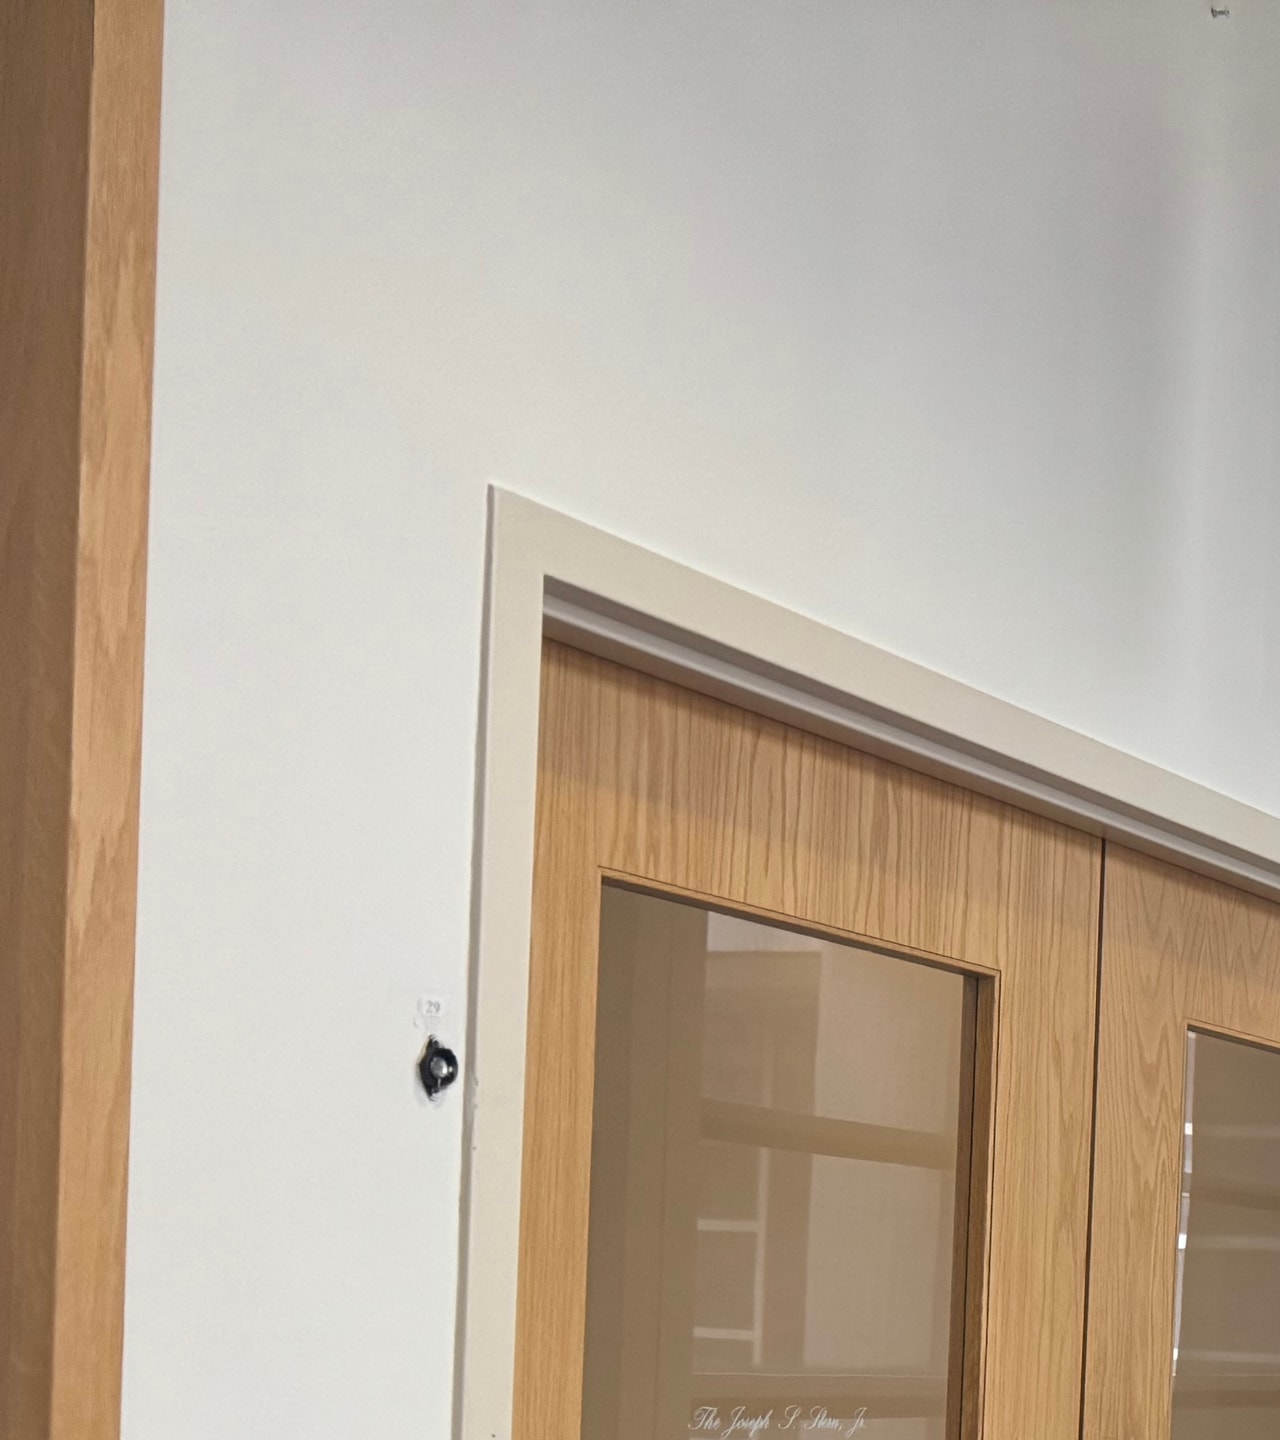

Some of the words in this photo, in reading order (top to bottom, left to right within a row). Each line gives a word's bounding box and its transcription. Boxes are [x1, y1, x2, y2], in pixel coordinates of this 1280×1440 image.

[688, 1405, 721, 1431] The
[721, 1405, 773, 1440] Joseph
[803, 1404, 843, 1431] Stern,
